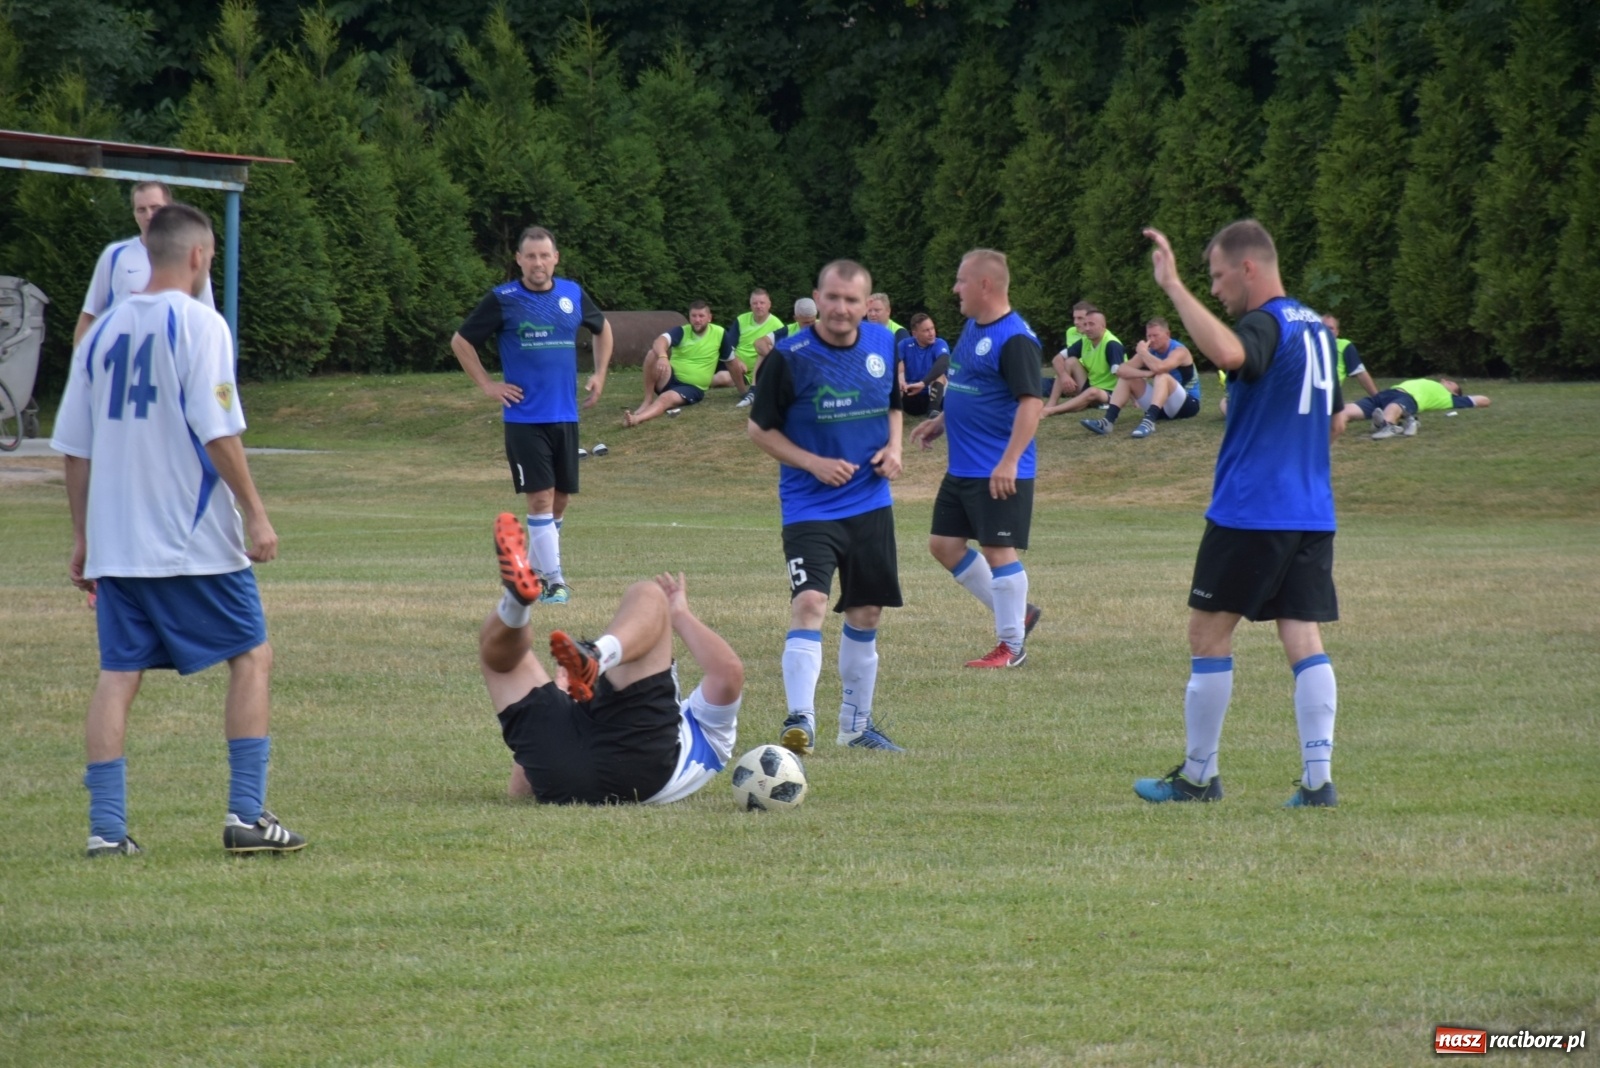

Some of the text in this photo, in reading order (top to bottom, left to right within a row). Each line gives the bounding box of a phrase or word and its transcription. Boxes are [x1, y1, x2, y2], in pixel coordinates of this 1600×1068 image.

[103, 333, 158, 421] 14
[1298, 329, 1333, 416] 14
[836, 398, 852, 407] BUD
[1305, 739, 1333, 749] COL
